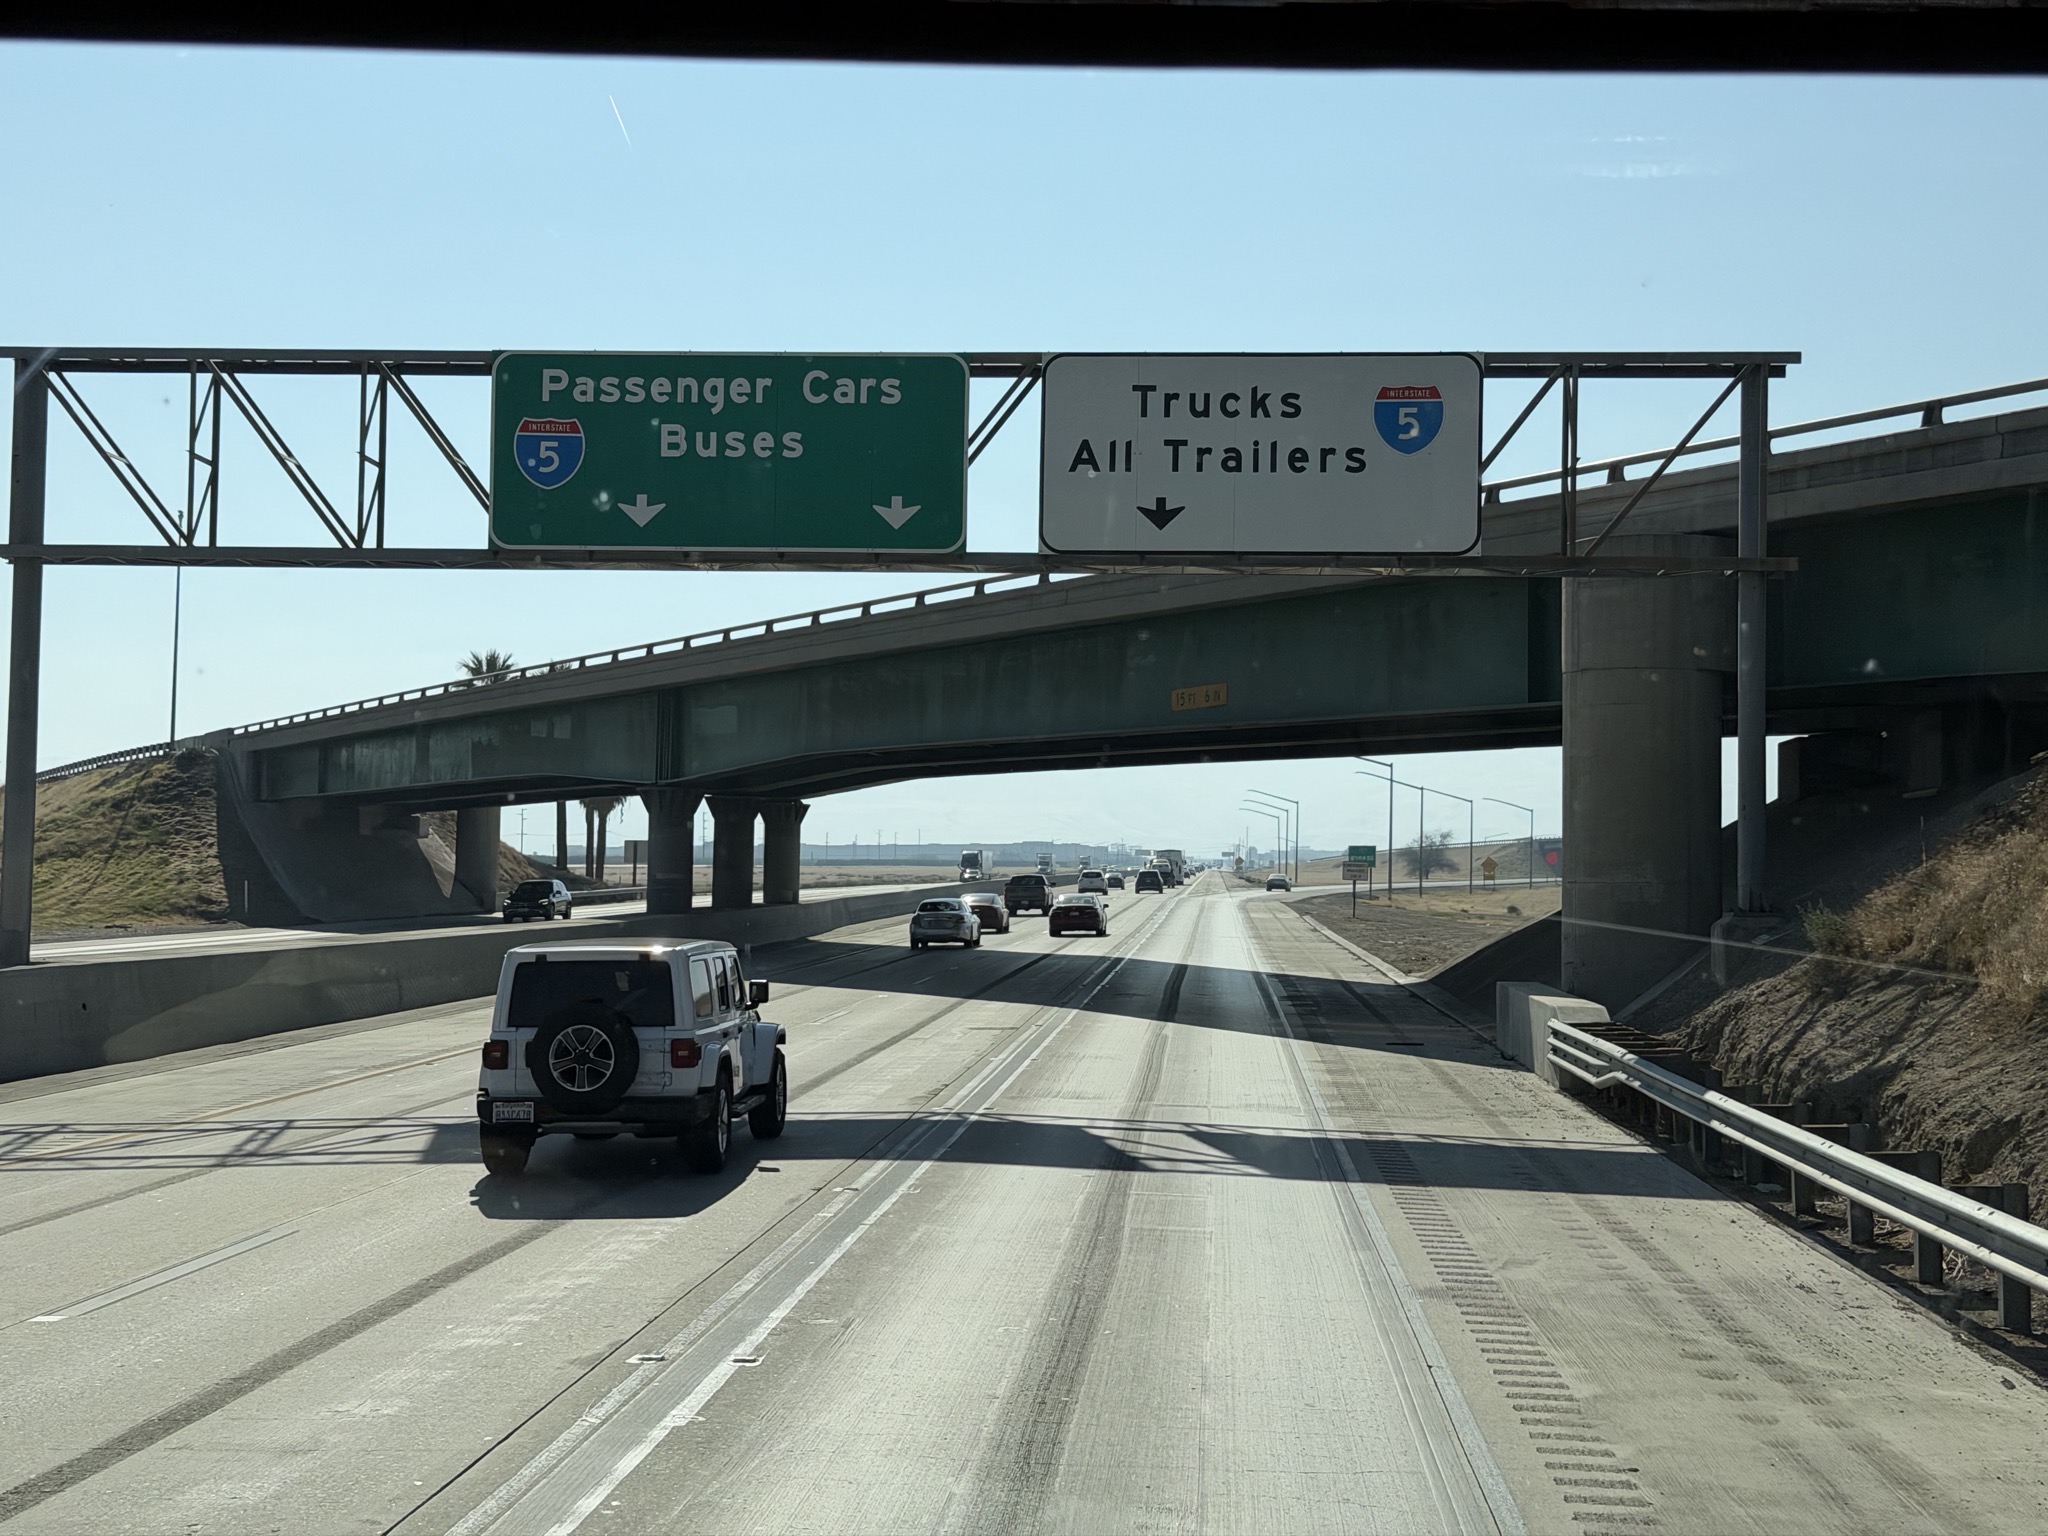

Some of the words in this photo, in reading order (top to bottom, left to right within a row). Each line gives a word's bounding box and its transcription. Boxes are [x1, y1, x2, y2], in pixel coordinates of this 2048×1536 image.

[542, 368, 772, 414] Passenger
[802, 370, 902, 404] Cars
[1132, 384, 1302, 418] Trucks
[1386, 389, 1430, 398] INTERSTATE
[528, 423, 571, 432] INTERSTATE
[1398, 407, 1420, 440] 5
[538, 441, 560, 473] 5
[660, 424, 804, 458] Buses
[1069, 439, 1132, 473] All
[1163, 439, 1367, 473] Trailers
